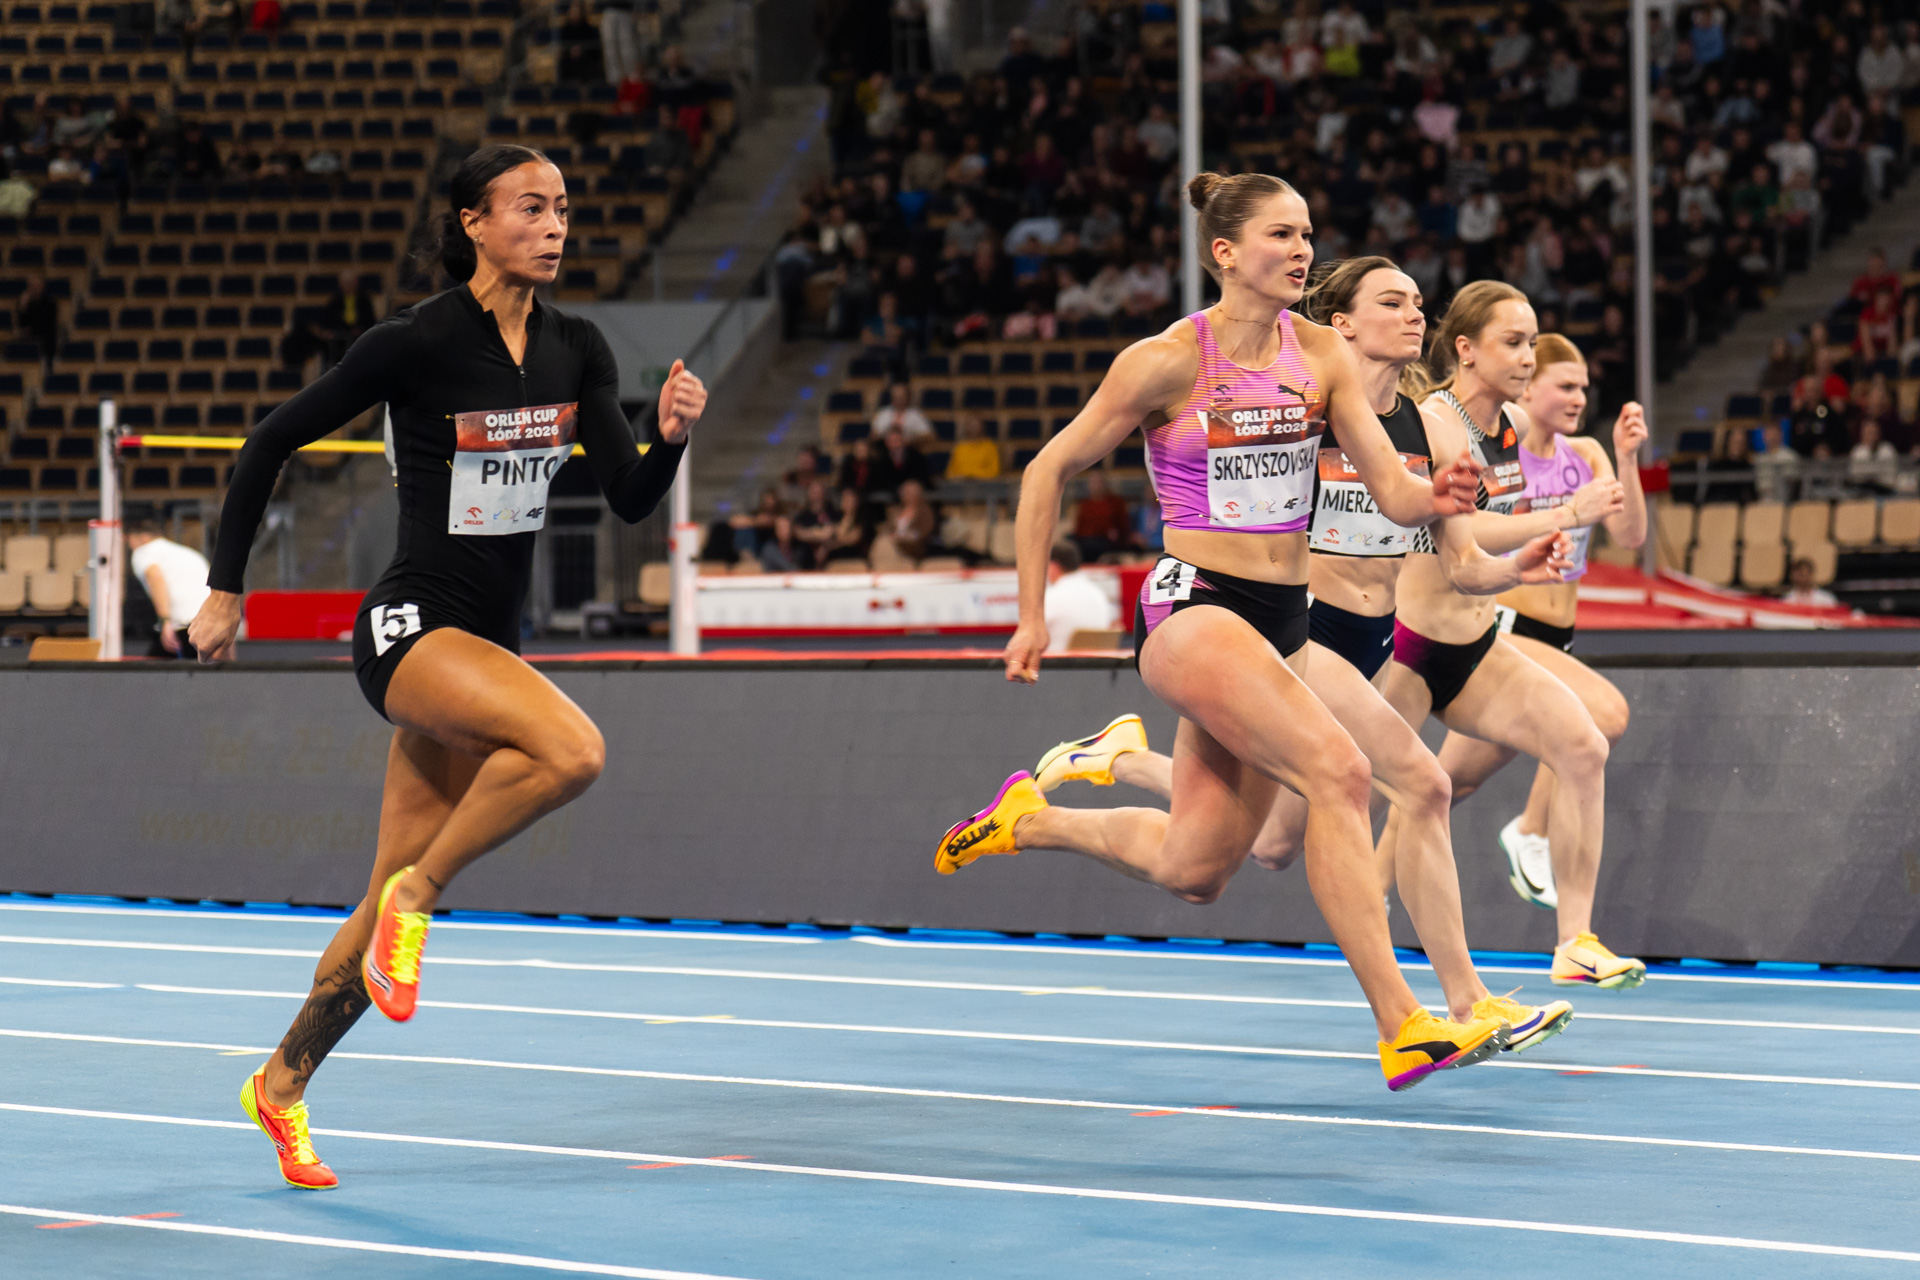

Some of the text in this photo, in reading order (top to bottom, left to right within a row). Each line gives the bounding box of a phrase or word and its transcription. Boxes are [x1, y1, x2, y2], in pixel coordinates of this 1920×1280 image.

[485, 408, 559, 428] ORLEN CUP
[1232, 406, 1307, 424] ORLEN CUP
[487, 425, 559, 442] ŁÓDŹ 2026
[1234, 421, 1309, 437] ŁÓDŹ 2026
[1284, 498, 1299, 509] 4F
[1322, 489, 1381, 515] MIERZ
[526, 506, 544, 519] 4F
[1156, 562, 1182, 597] 4
[381, 604, 408, 643] 5
